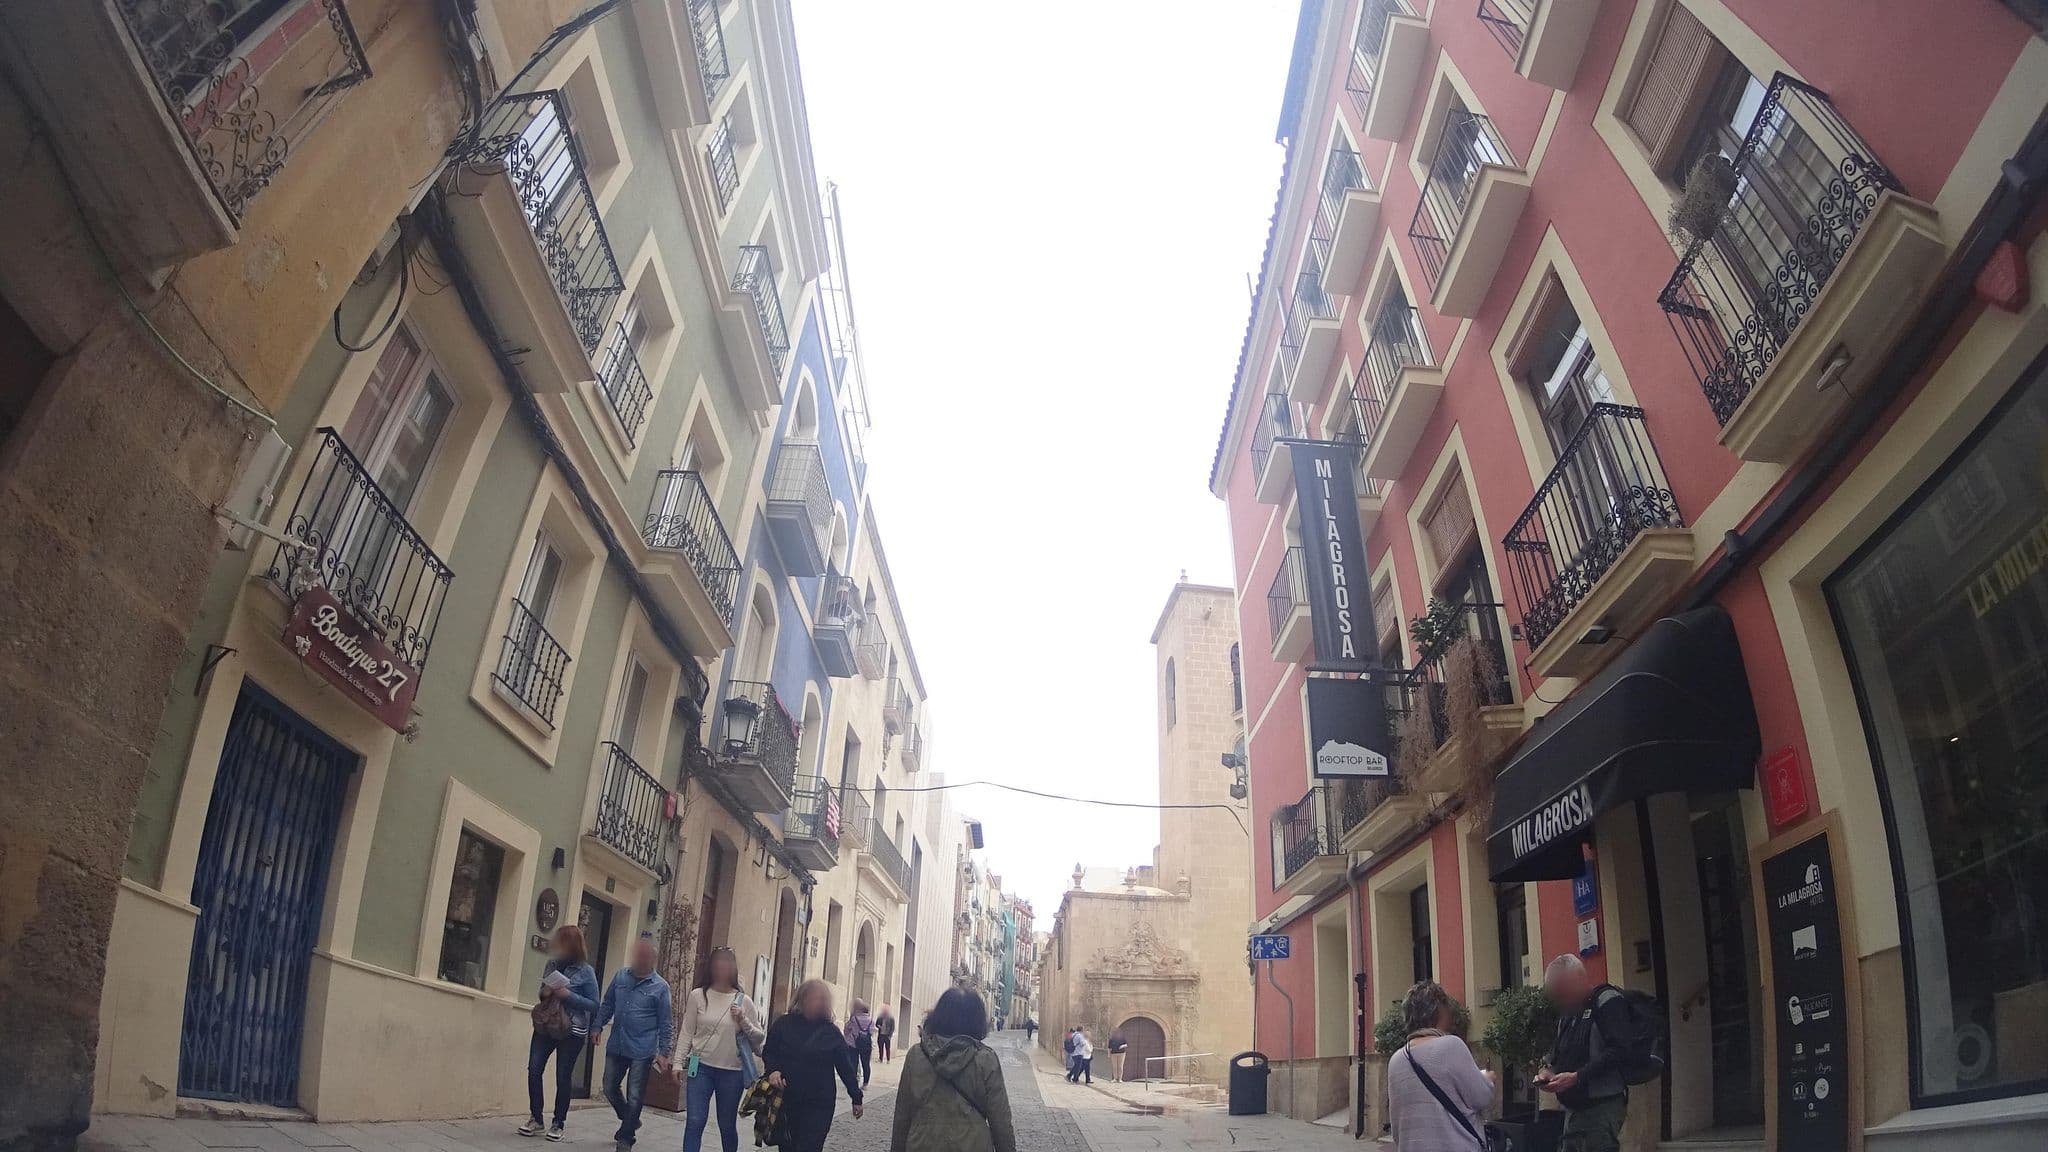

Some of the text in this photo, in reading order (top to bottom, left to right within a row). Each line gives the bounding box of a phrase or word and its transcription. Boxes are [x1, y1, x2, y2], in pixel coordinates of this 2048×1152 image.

[1315, 458, 1355, 659] MILAGROSA
[1966, 574, 1999, 618] LA
[311, 604, 408, 702] Boutique 27
[1320, 755, 1383, 765] ROOFTOP BAR
[1511, 784, 1593, 859] MILAGROSA
[1778, 882, 1823, 908] LA MILAGROSA
